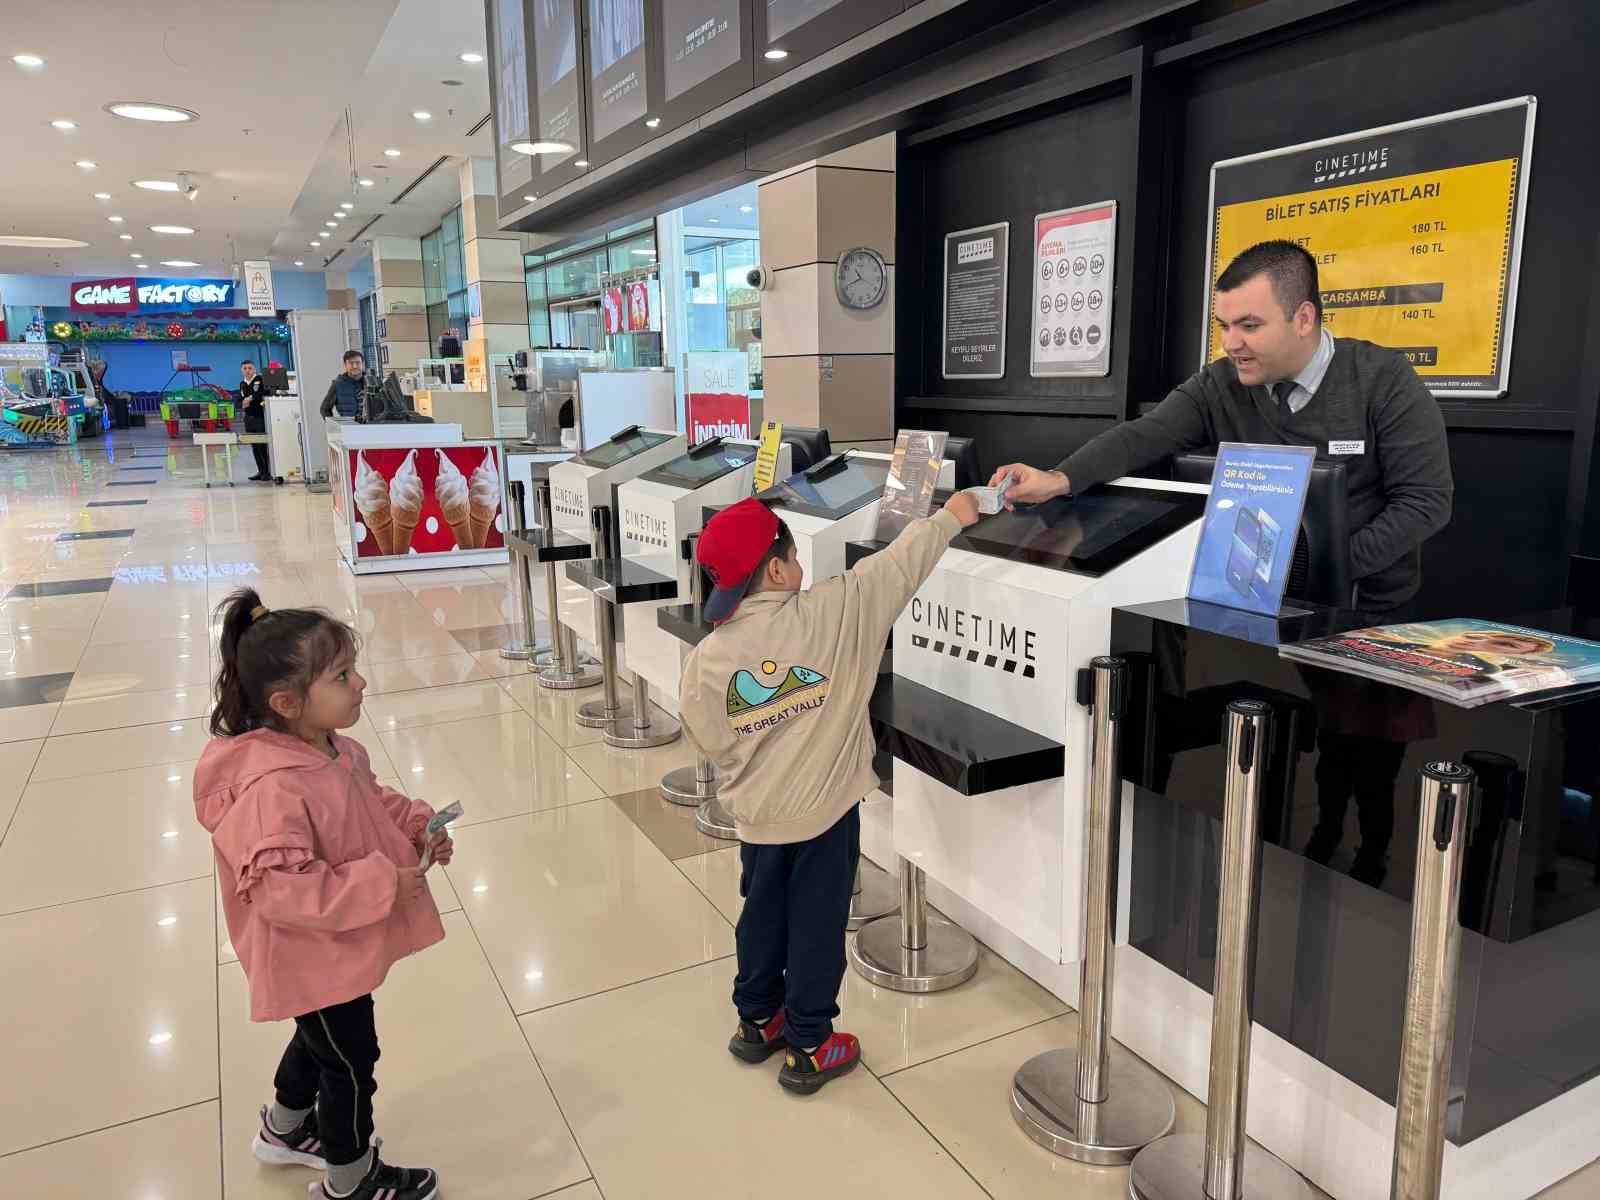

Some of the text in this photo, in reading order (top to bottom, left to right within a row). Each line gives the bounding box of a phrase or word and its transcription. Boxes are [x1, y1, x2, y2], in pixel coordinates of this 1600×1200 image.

[1315, 148, 1389, 173] CINETIME
[1266, 182, 1441, 221] BİLET SATIŞ FİYATLARI
[1412, 221, 1447, 234] 180 TL
[1410, 243, 1445, 255] 160 TL
[74, 284, 131, 305] GAME
[1402, 309, 1435, 320] 140 TL
[1419, 352, 1432, 363] TL
[704, 367, 736, 389] SALE
[694, 419, 748, 446] İNDİRİM
[1223, 469, 1236, 479] QR
[1238, 470, 1256, 480] Kod
[554, 485, 584, 509] CINETIME
[625, 508, 667, 538] CINETIME
[911, 597, 1036, 661] CINETIME
[735, 696, 825, 736] THE GREAT VALLE
